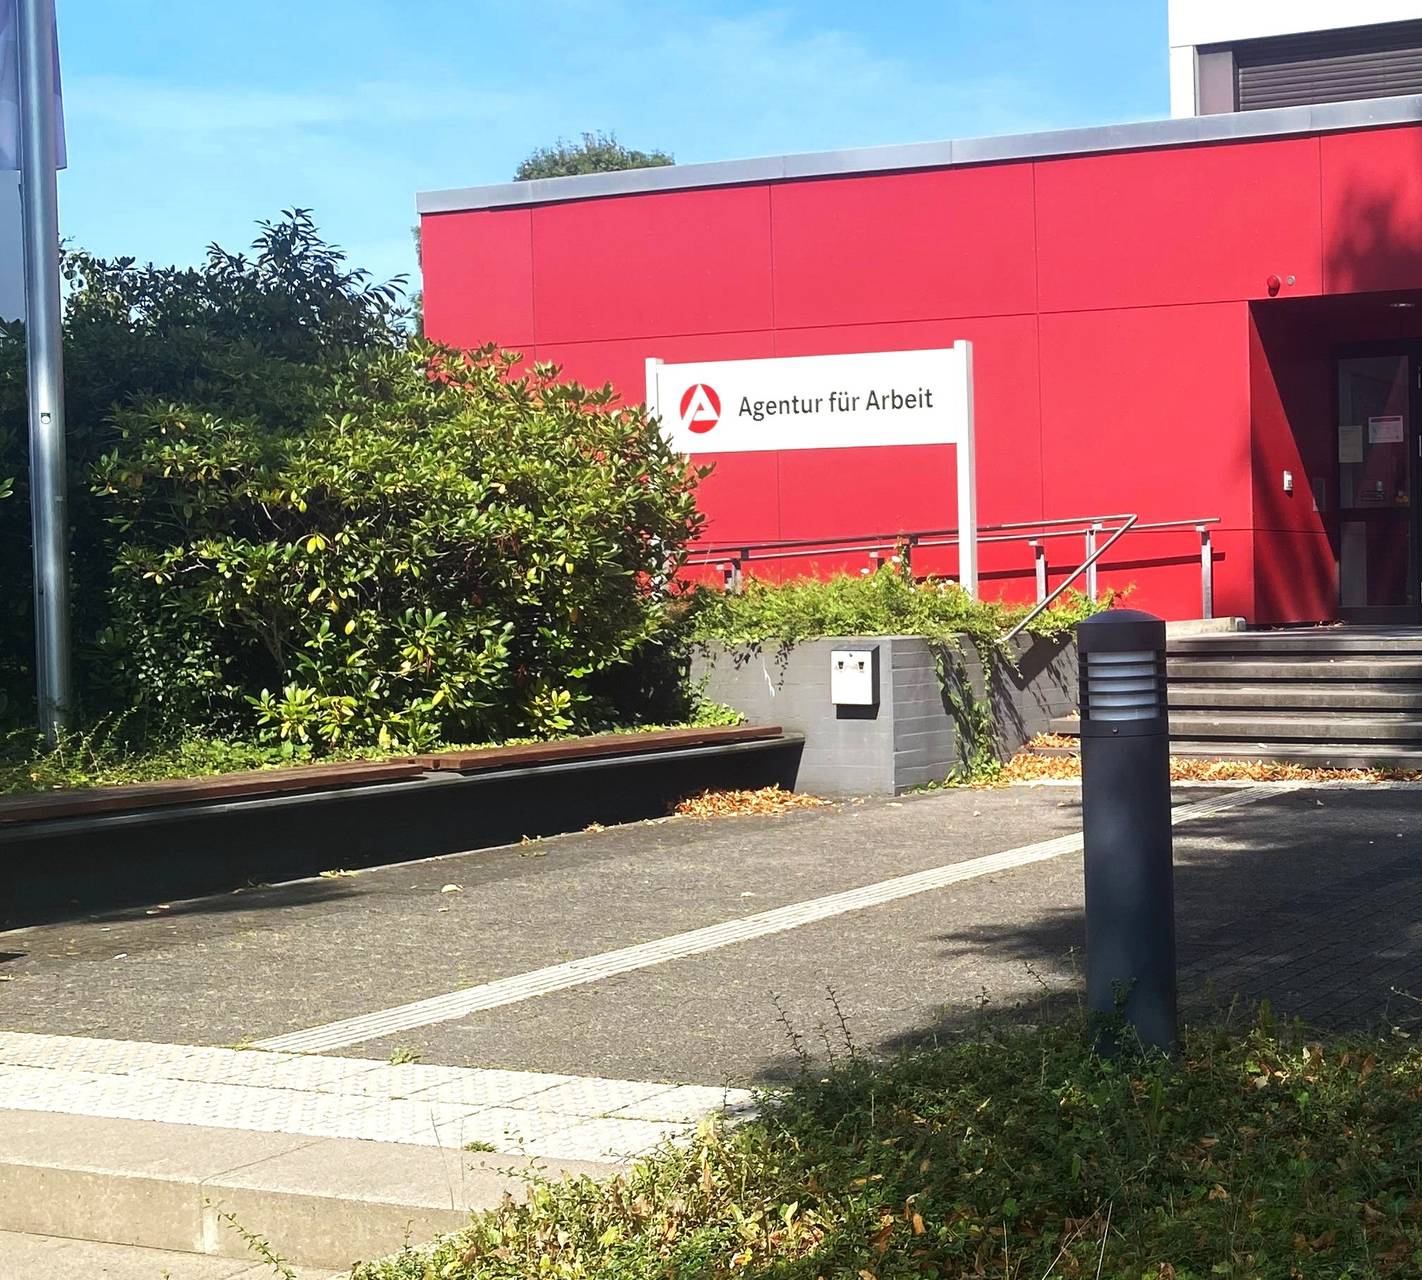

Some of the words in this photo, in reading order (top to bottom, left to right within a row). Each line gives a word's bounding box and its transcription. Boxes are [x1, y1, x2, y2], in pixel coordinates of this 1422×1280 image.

[738, 395, 823, 422] Agentur
[829, 391, 860, 413] für
[865, 388, 934, 411] Arbeit
